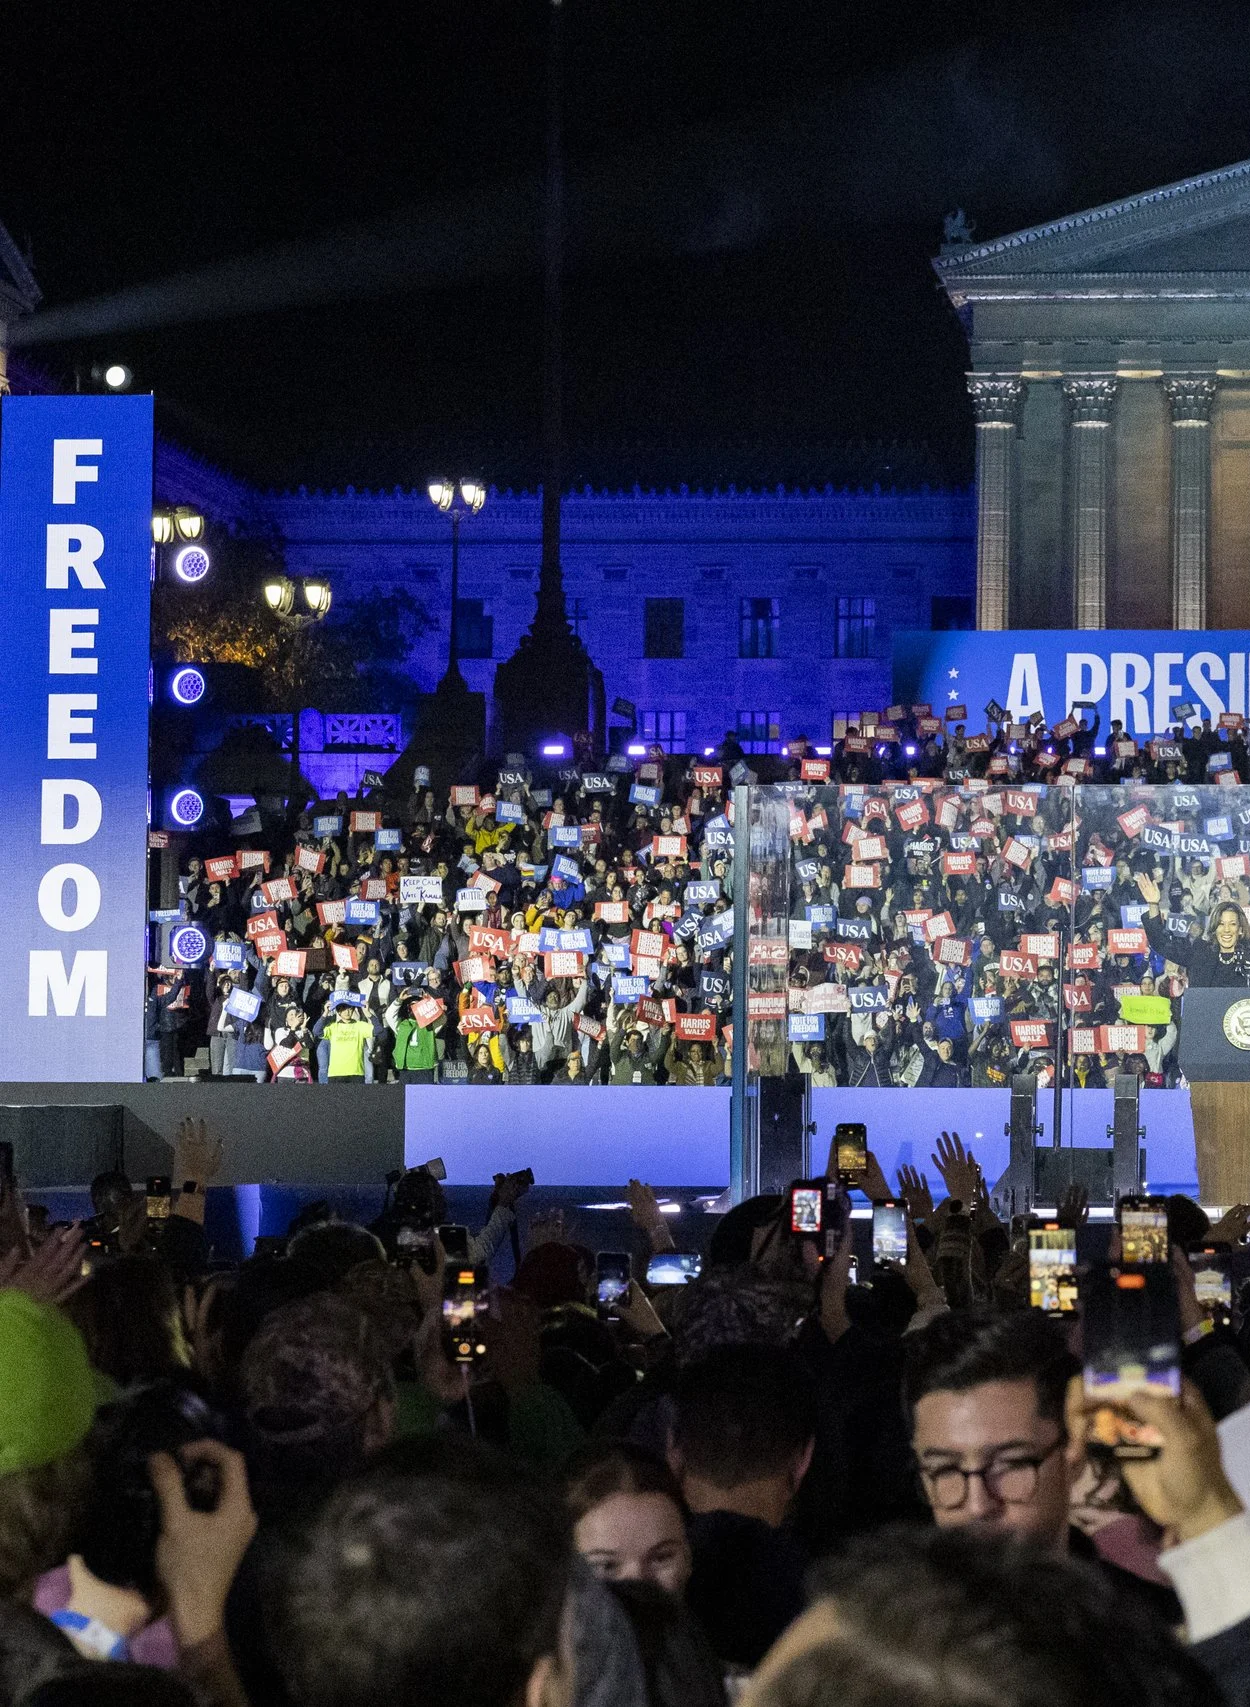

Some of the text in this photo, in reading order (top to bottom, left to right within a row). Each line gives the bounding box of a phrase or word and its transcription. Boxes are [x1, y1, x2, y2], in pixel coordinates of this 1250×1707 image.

[1003, 653, 1046, 733] A
[28, 439, 107, 1017] FREEDOM
[966, 739, 988, 749] USA
[1160, 746, 1181, 757] USA
[364, 773, 382, 785] USA
[500, 773, 523, 783] USA
[584, 777, 611, 788] USA
[695, 771, 720, 783] USA
[895, 789, 918, 799] USA
[1008, 797, 1034, 811] USA
[1175, 795, 1199, 806] USA
[864, 804, 887, 816] USA
[707, 831, 735, 844] USA
[952, 837, 979, 848] USA
[1050, 837, 1073, 848] USA
[1144, 830, 1172, 849] USA
[1181, 839, 1209, 852] USA
[210, 860, 234, 872] HARRIS
[948, 856, 972, 865] HARRIS
[689, 886, 717, 899] USA
[350, 903, 362, 911] VOTE
[1000, 893, 1025, 910] USA
[248, 919, 276, 935] USA
[676, 912, 703, 938] USA
[839, 924, 869, 938] USA
[257, 936, 281, 947] HARRIS
[472, 932, 504, 951] USA
[698, 930, 723, 949] USA
[1113, 933, 1142, 942] HARRIS
[826, 947, 858, 963] USA
[1002, 957, 1034, 974] USA
[617, 978, 645, 987] VOTE FOR
[702, 976, 731, 993] USA
[618, 986, 645, 995] FREEDOM
[851, 993, 886, 1008] USA
[1066, 990, 1089, 1006] USA
[975, 1008, 1001, 1016] FREEDOM
[465, 1014, 495, 1028] USA
[681, 1018, 710, 1028] HARRIS
[790, 1024, 818, 1033] FREEDOM
[1015, 1026, 1045, 1035] HARRIS
